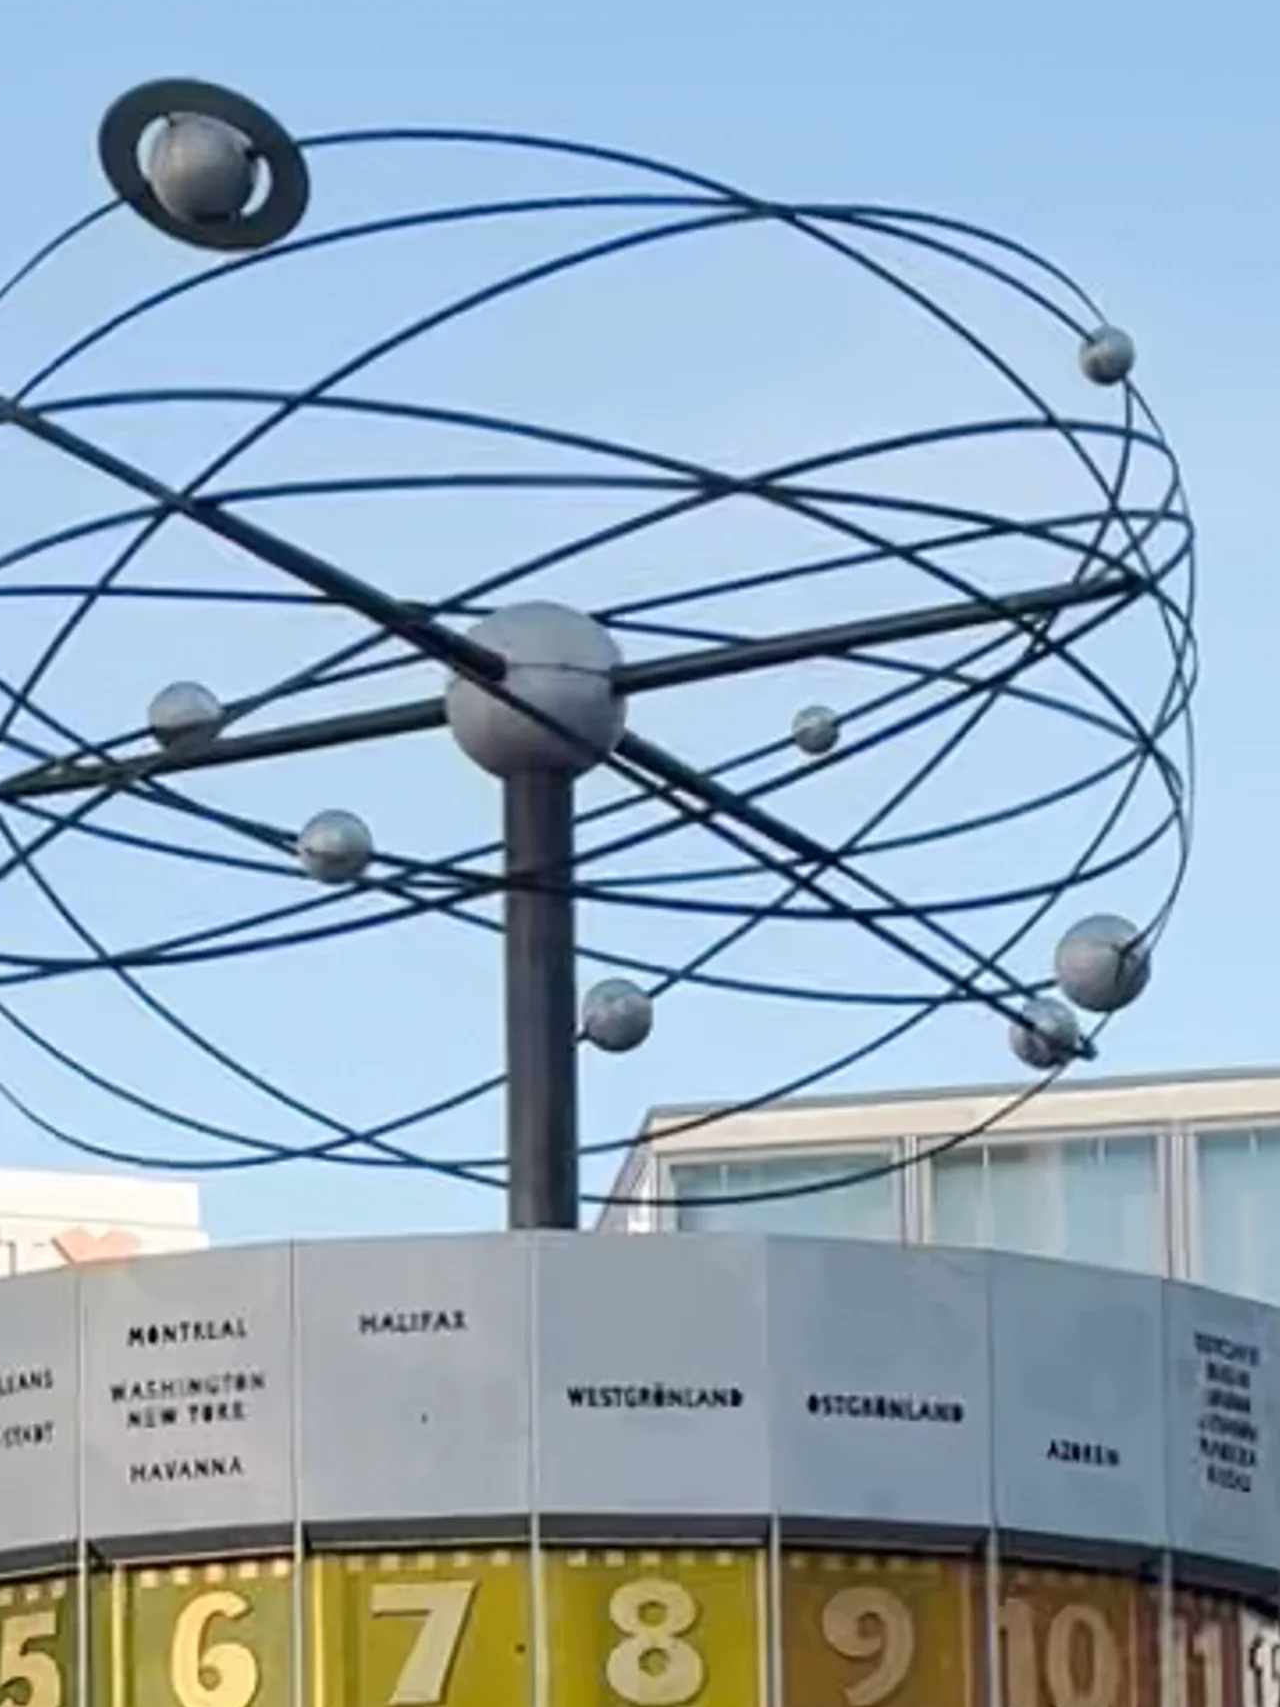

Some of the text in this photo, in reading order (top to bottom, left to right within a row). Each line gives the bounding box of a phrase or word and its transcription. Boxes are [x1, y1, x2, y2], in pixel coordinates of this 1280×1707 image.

[127, 1318, 247, 1346] MONTREAL
[359, 1310, 467, 1335] HALIFAX
[110, 1371, 266, 1402] WASHINGTON
[567, 1383, 744, 1409] WESTGRÖNLAND
[127, 1400, 245, 1430] NEW YORK
[130, 1456, 243, 1483] HAVANNA
[370, 1579, 478, 1707] 7
[606, 1578, 706, 1706] 8
